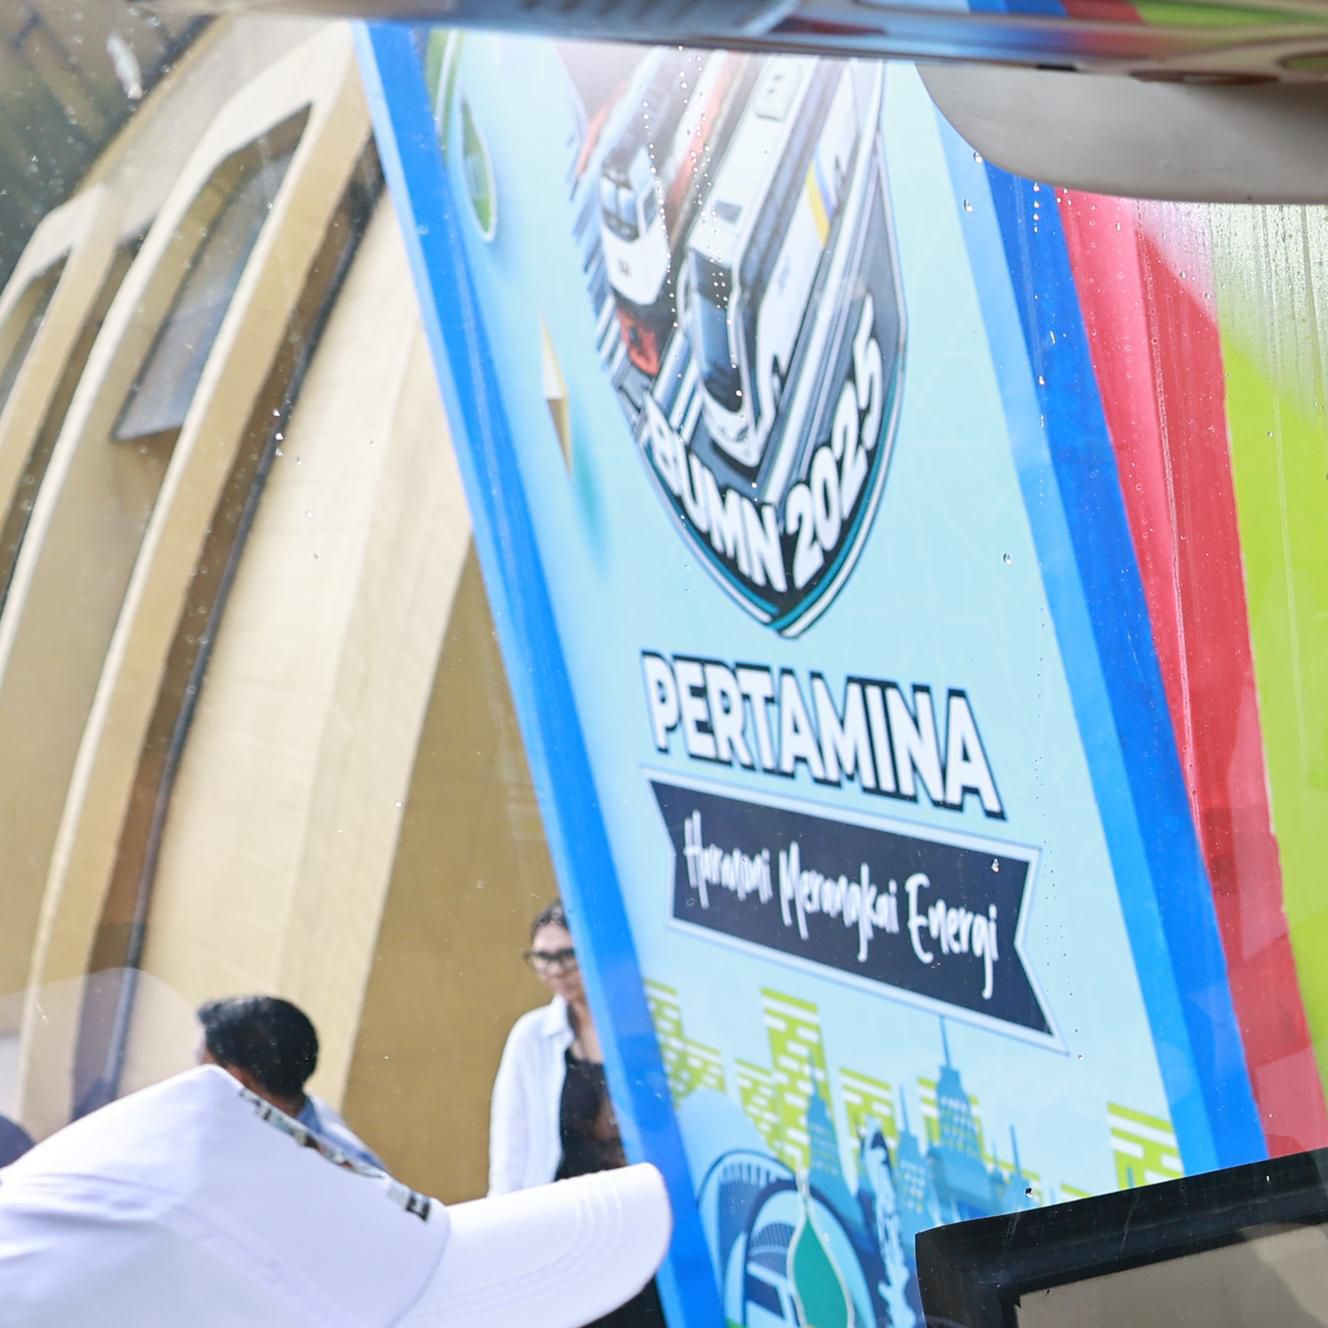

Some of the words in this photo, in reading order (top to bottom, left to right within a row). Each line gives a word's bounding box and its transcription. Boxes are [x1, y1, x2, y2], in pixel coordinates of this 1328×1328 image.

[643, 391, 787, 592] BUMN
[785, 292, 884, 590] 2025
[641, 650, 1006, 821] PERTAMINA
[905, 872, 1000, 1000] Energi
